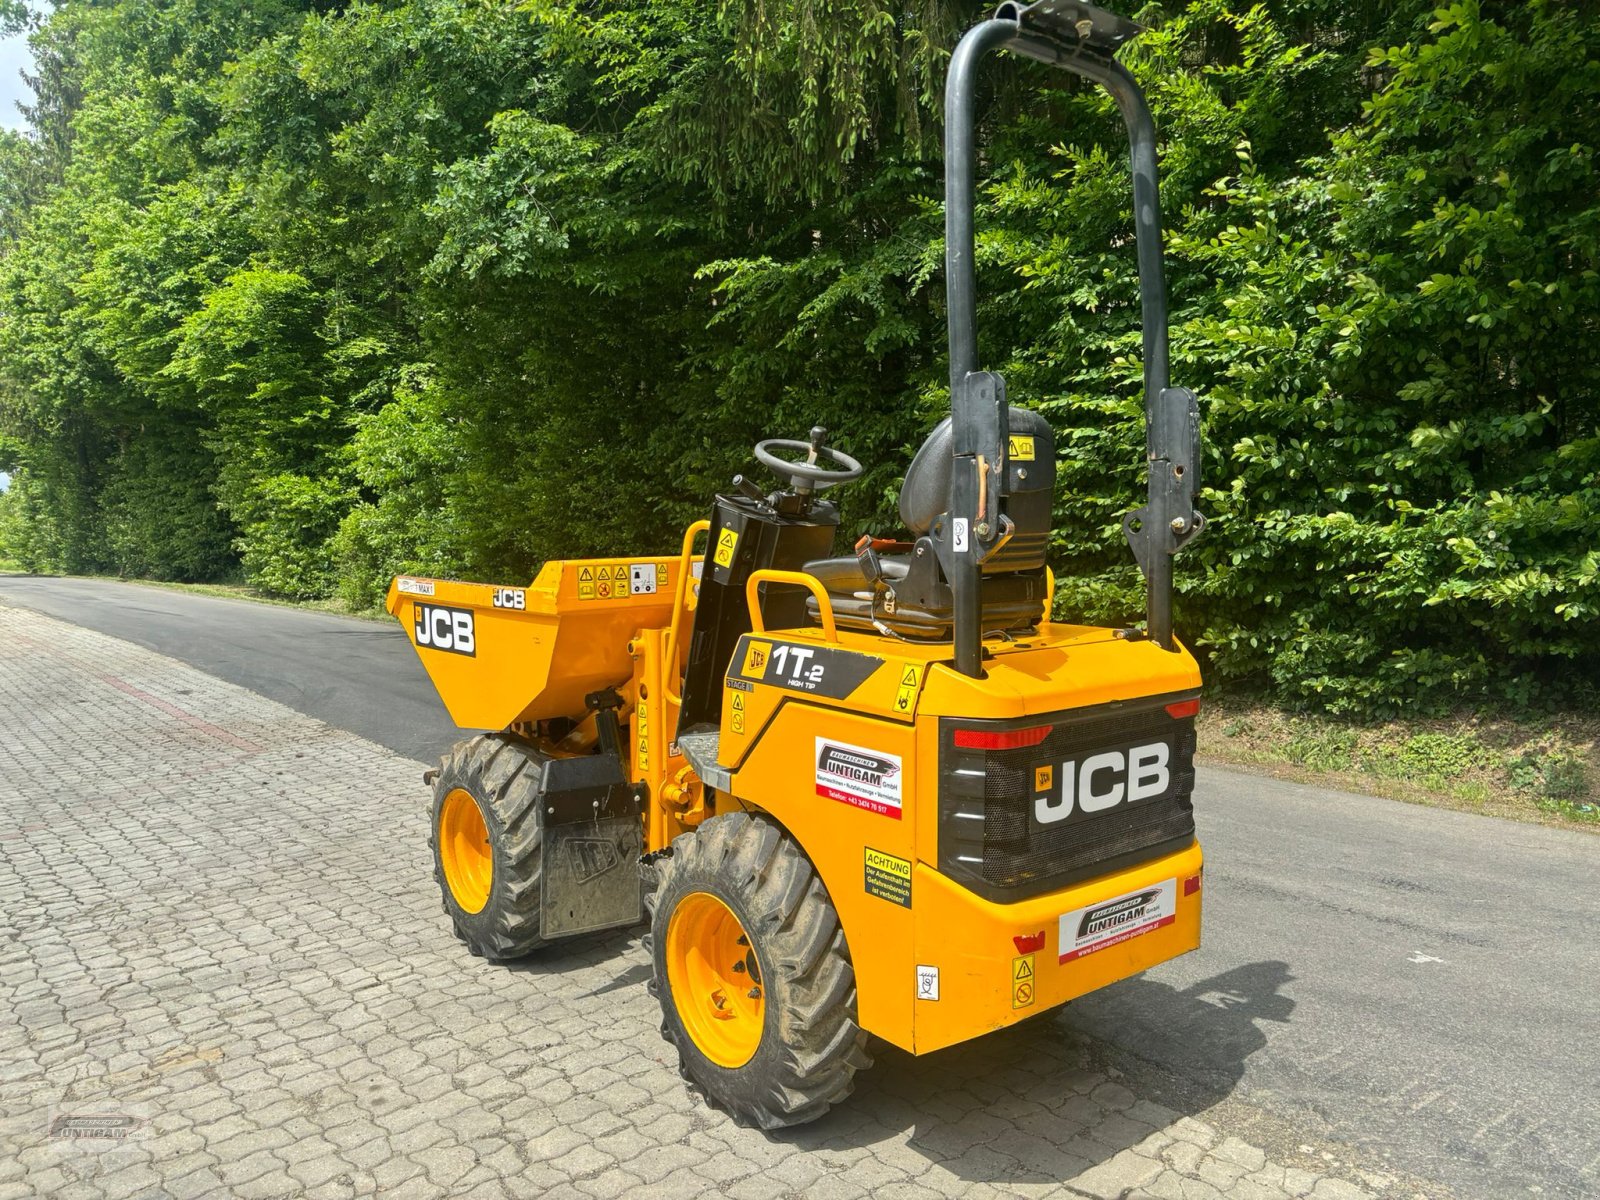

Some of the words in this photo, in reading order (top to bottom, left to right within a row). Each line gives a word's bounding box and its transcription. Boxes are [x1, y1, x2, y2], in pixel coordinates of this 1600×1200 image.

[493, 589, 526, 610] JCB
[415, 607, 475, 653] JCB
[750, 650, 765, 668] JCB
[727, 679, 746, 691] STAGE
[787, 679, 804, 688] HIGH
[804, 682, 816, 690] TIP
[831, 752, 875, 767] BAUMASCHINEN
[882, 781, 898, 791] GmbH
[1034, 742, 1170, 824] JCB
[867, 853, 909, 875] ACHTUNG
[866, 867, 876, 875] Der
[875, 871, 903, 886] Aufenthalt
[903, 880, 911, 888] im
[867, 876, 910, 897] Gefahrenbereich
[879, 890, 904, 904] verboten!
[1146, 905, 1160, 914] GmbH
